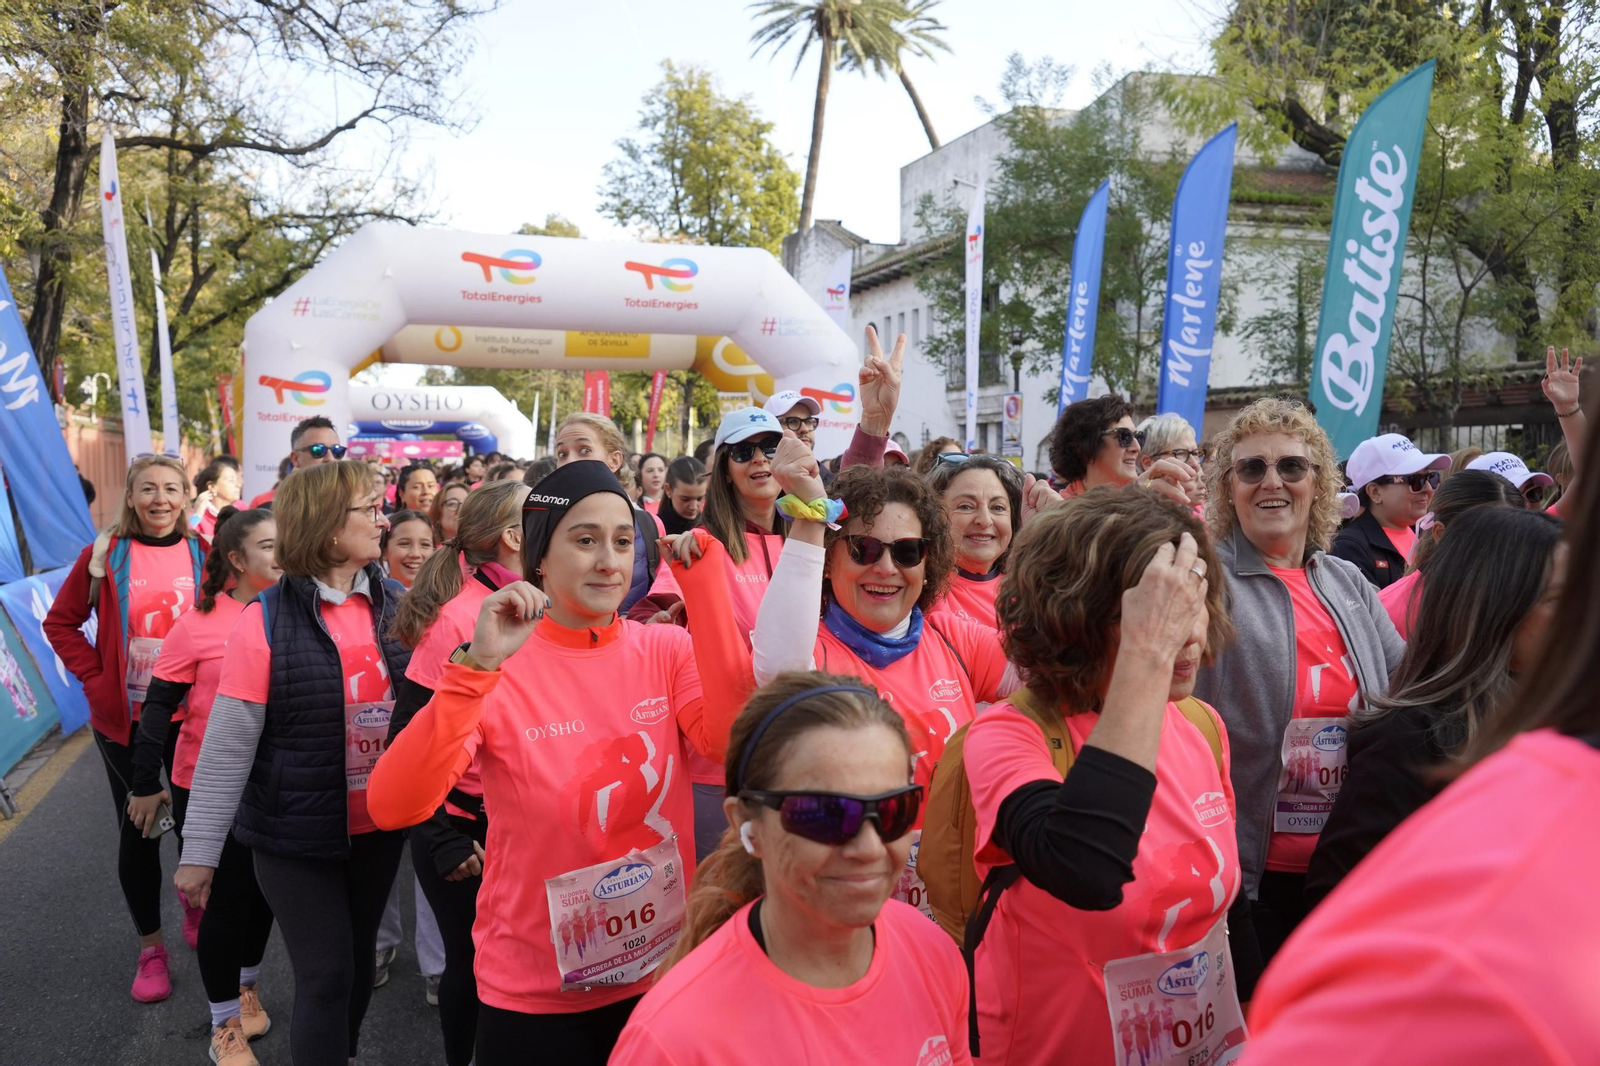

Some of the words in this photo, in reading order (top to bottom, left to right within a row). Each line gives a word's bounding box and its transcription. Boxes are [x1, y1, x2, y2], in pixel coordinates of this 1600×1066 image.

[1321, 144, 1408, 417] Batiste
[461, 290, 542, 305] TotalEnergies
[624, 297, 699, 311] TotalEnergies
[1165, 240, 1216, 387] Marlene
[475, 334, 509, 344] Instituto
[512, 336, 553, 346] Municipal
[487, 346, 499, 354] de
[501, 346, 540, 355] Deportes
[371, 392, 463, 411] OYSHO
[528, 493, 570, 506] salomon
[735, 573, 767, 583] OYSHO
[525, 718, 585, 742] OYSHO
[348, 777, 367, 786] SHO
[1288, 816, 1324, 827] OYSHO
[599, 871, 650, 896] ASTURIANA
[568, 888, 589, 898] DORSAL
[561, 895, 591, 908] SUMA
[605, 902, 656, 937] 016
[622, 934, 647, 951] 1020
[582, 961, 613, 977] CARRERA
[614, 956, 623, 965] DE
[624, 953, 633, 963] LA
[633, 944, 652, 960] MUJER
[1120, 985, 1154, 1001] SUMA
[1172, 1002, 1215, 1048] 016
